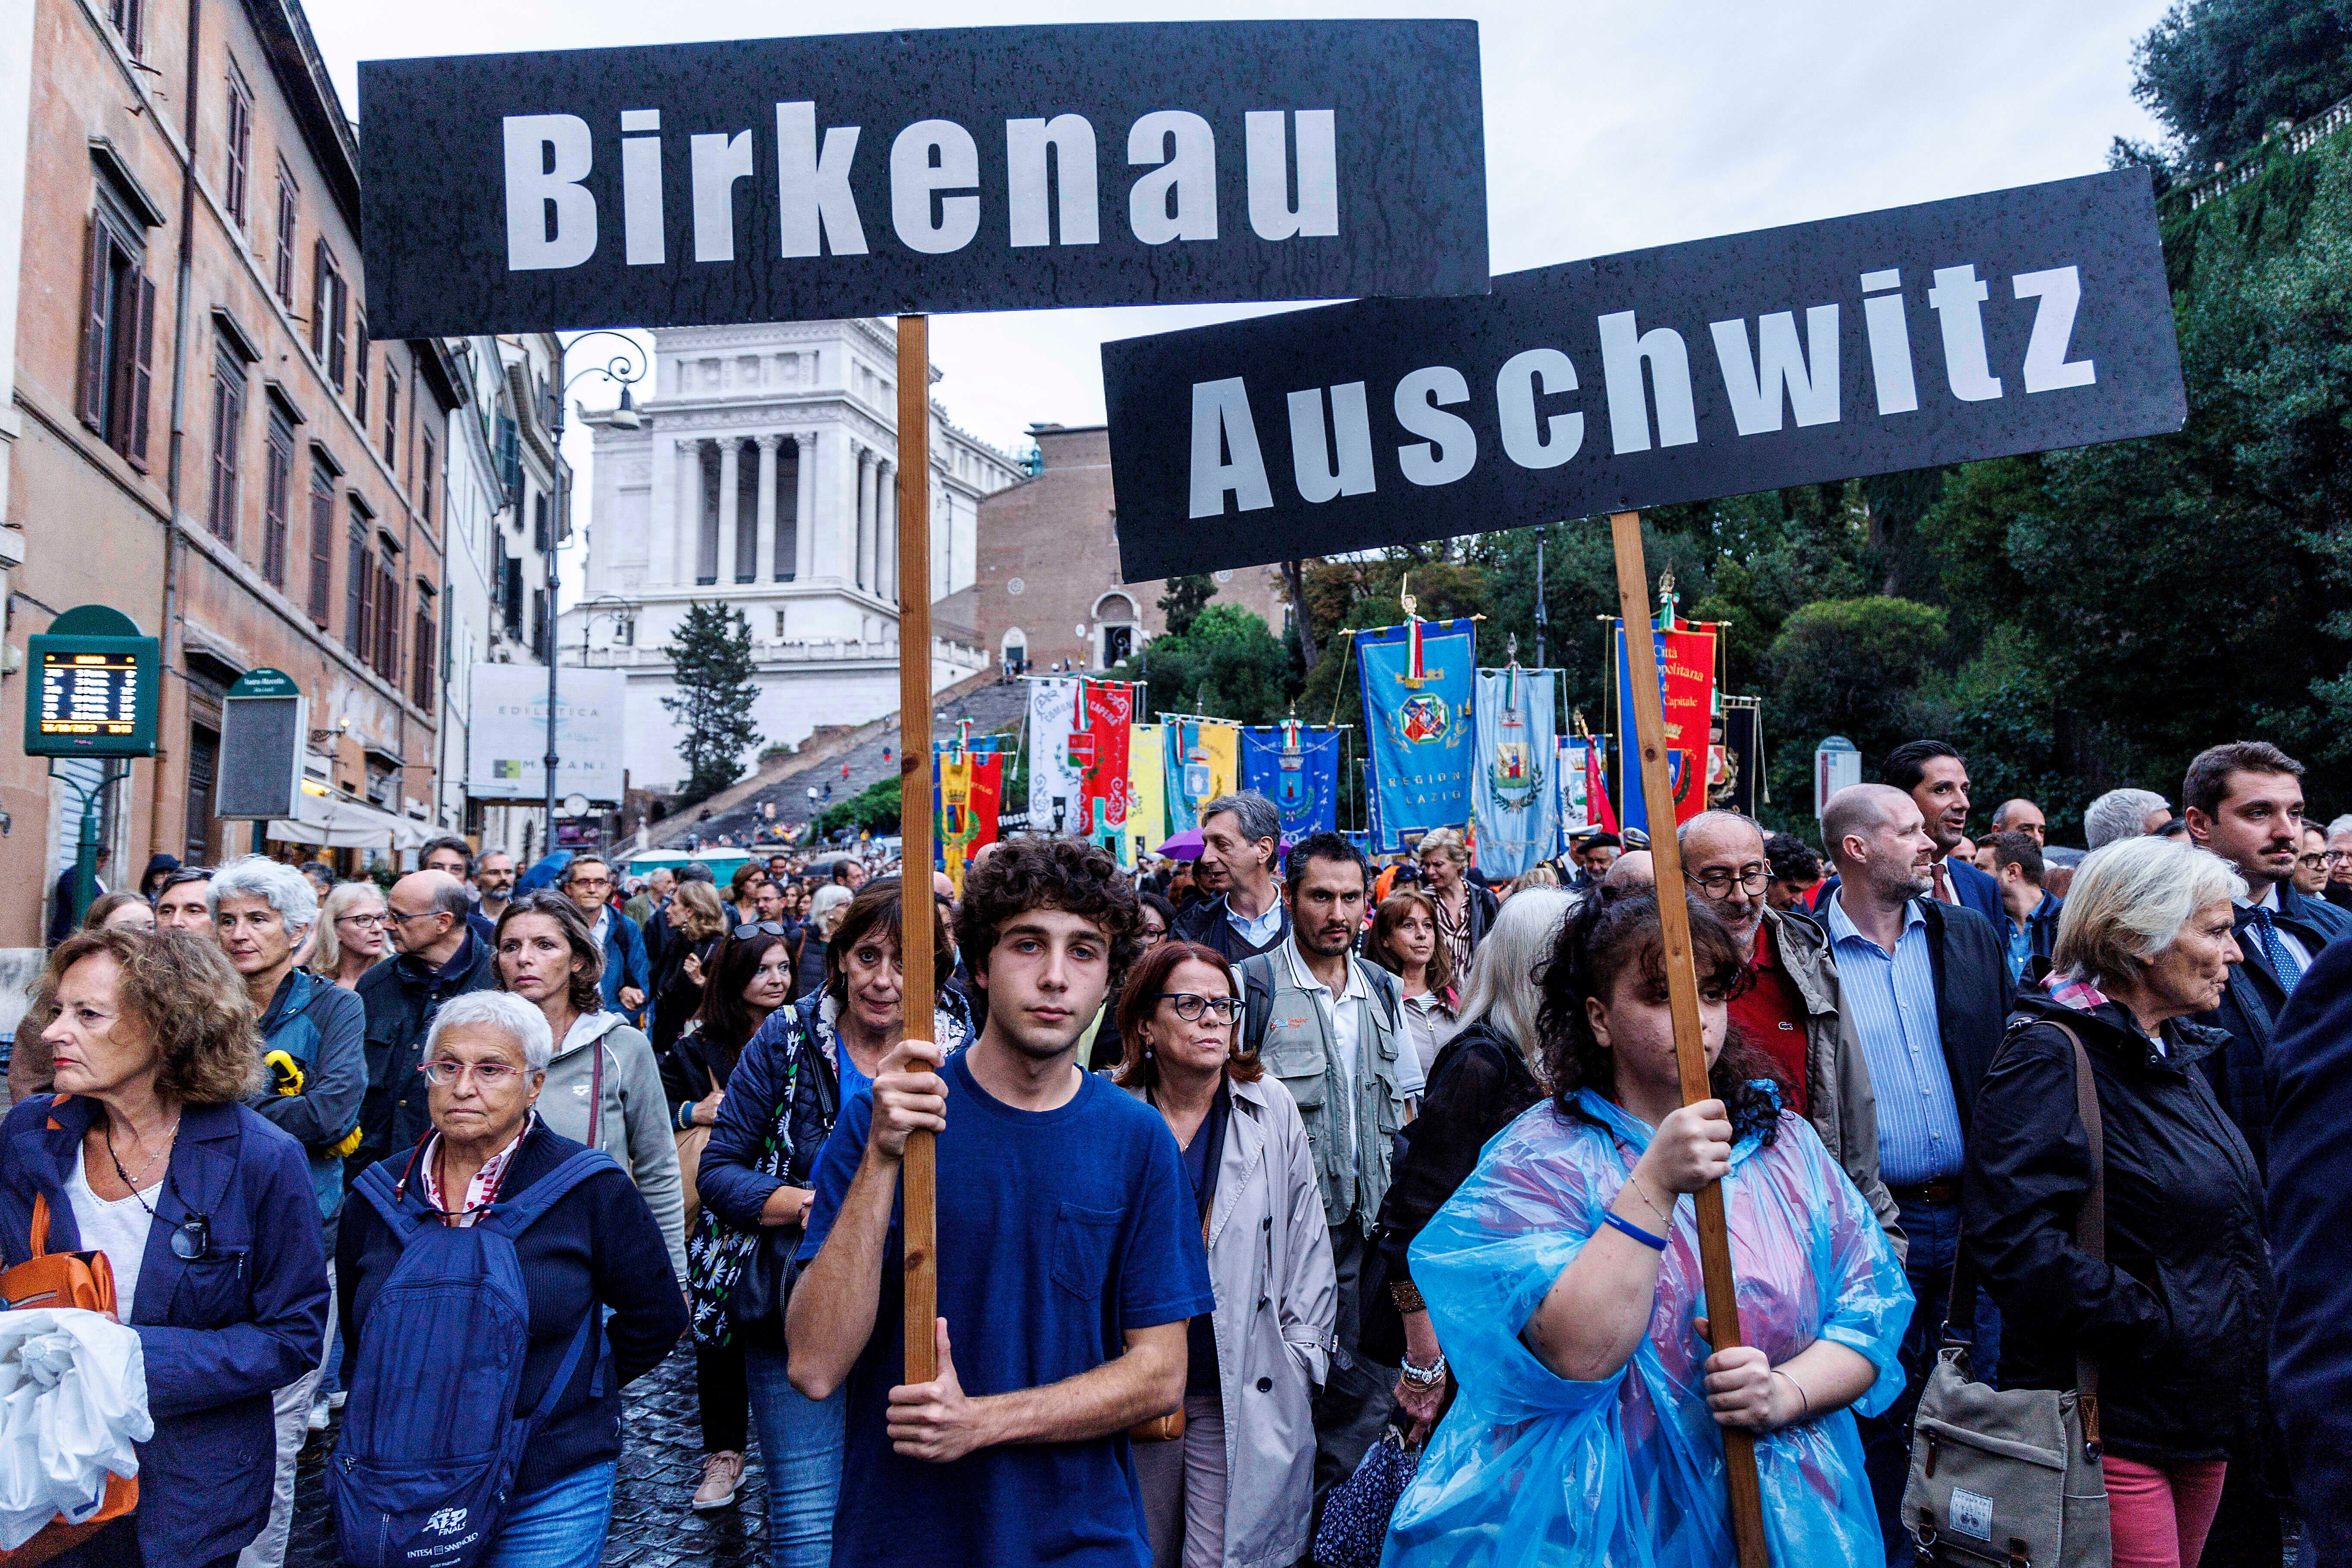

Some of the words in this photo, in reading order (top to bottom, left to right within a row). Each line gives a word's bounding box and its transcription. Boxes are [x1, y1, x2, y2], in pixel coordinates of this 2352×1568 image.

[503, 101, 1339, 270] Birkenau
[1190, 264, 2096, 518] Auschwitz
[1654, 645, 1678, 659] Città
[1657, 663, 1704, 682] opolitana
[1662, 681, 1670, 691] di
[1664, 695, 1698, 709] Capitale
[498, 706, 598, 716] EDILTICA
[1089, 700, 1118, 726] CAPENA
[523, 760, 605, 770] MANI
[1405, 790, 1460, 805] LAZIO
[422, 1508, 467, 1532] ATP
[439, 1521, 467, 1536] FINALS
[407, 1549, 432, 1558] INTESA
